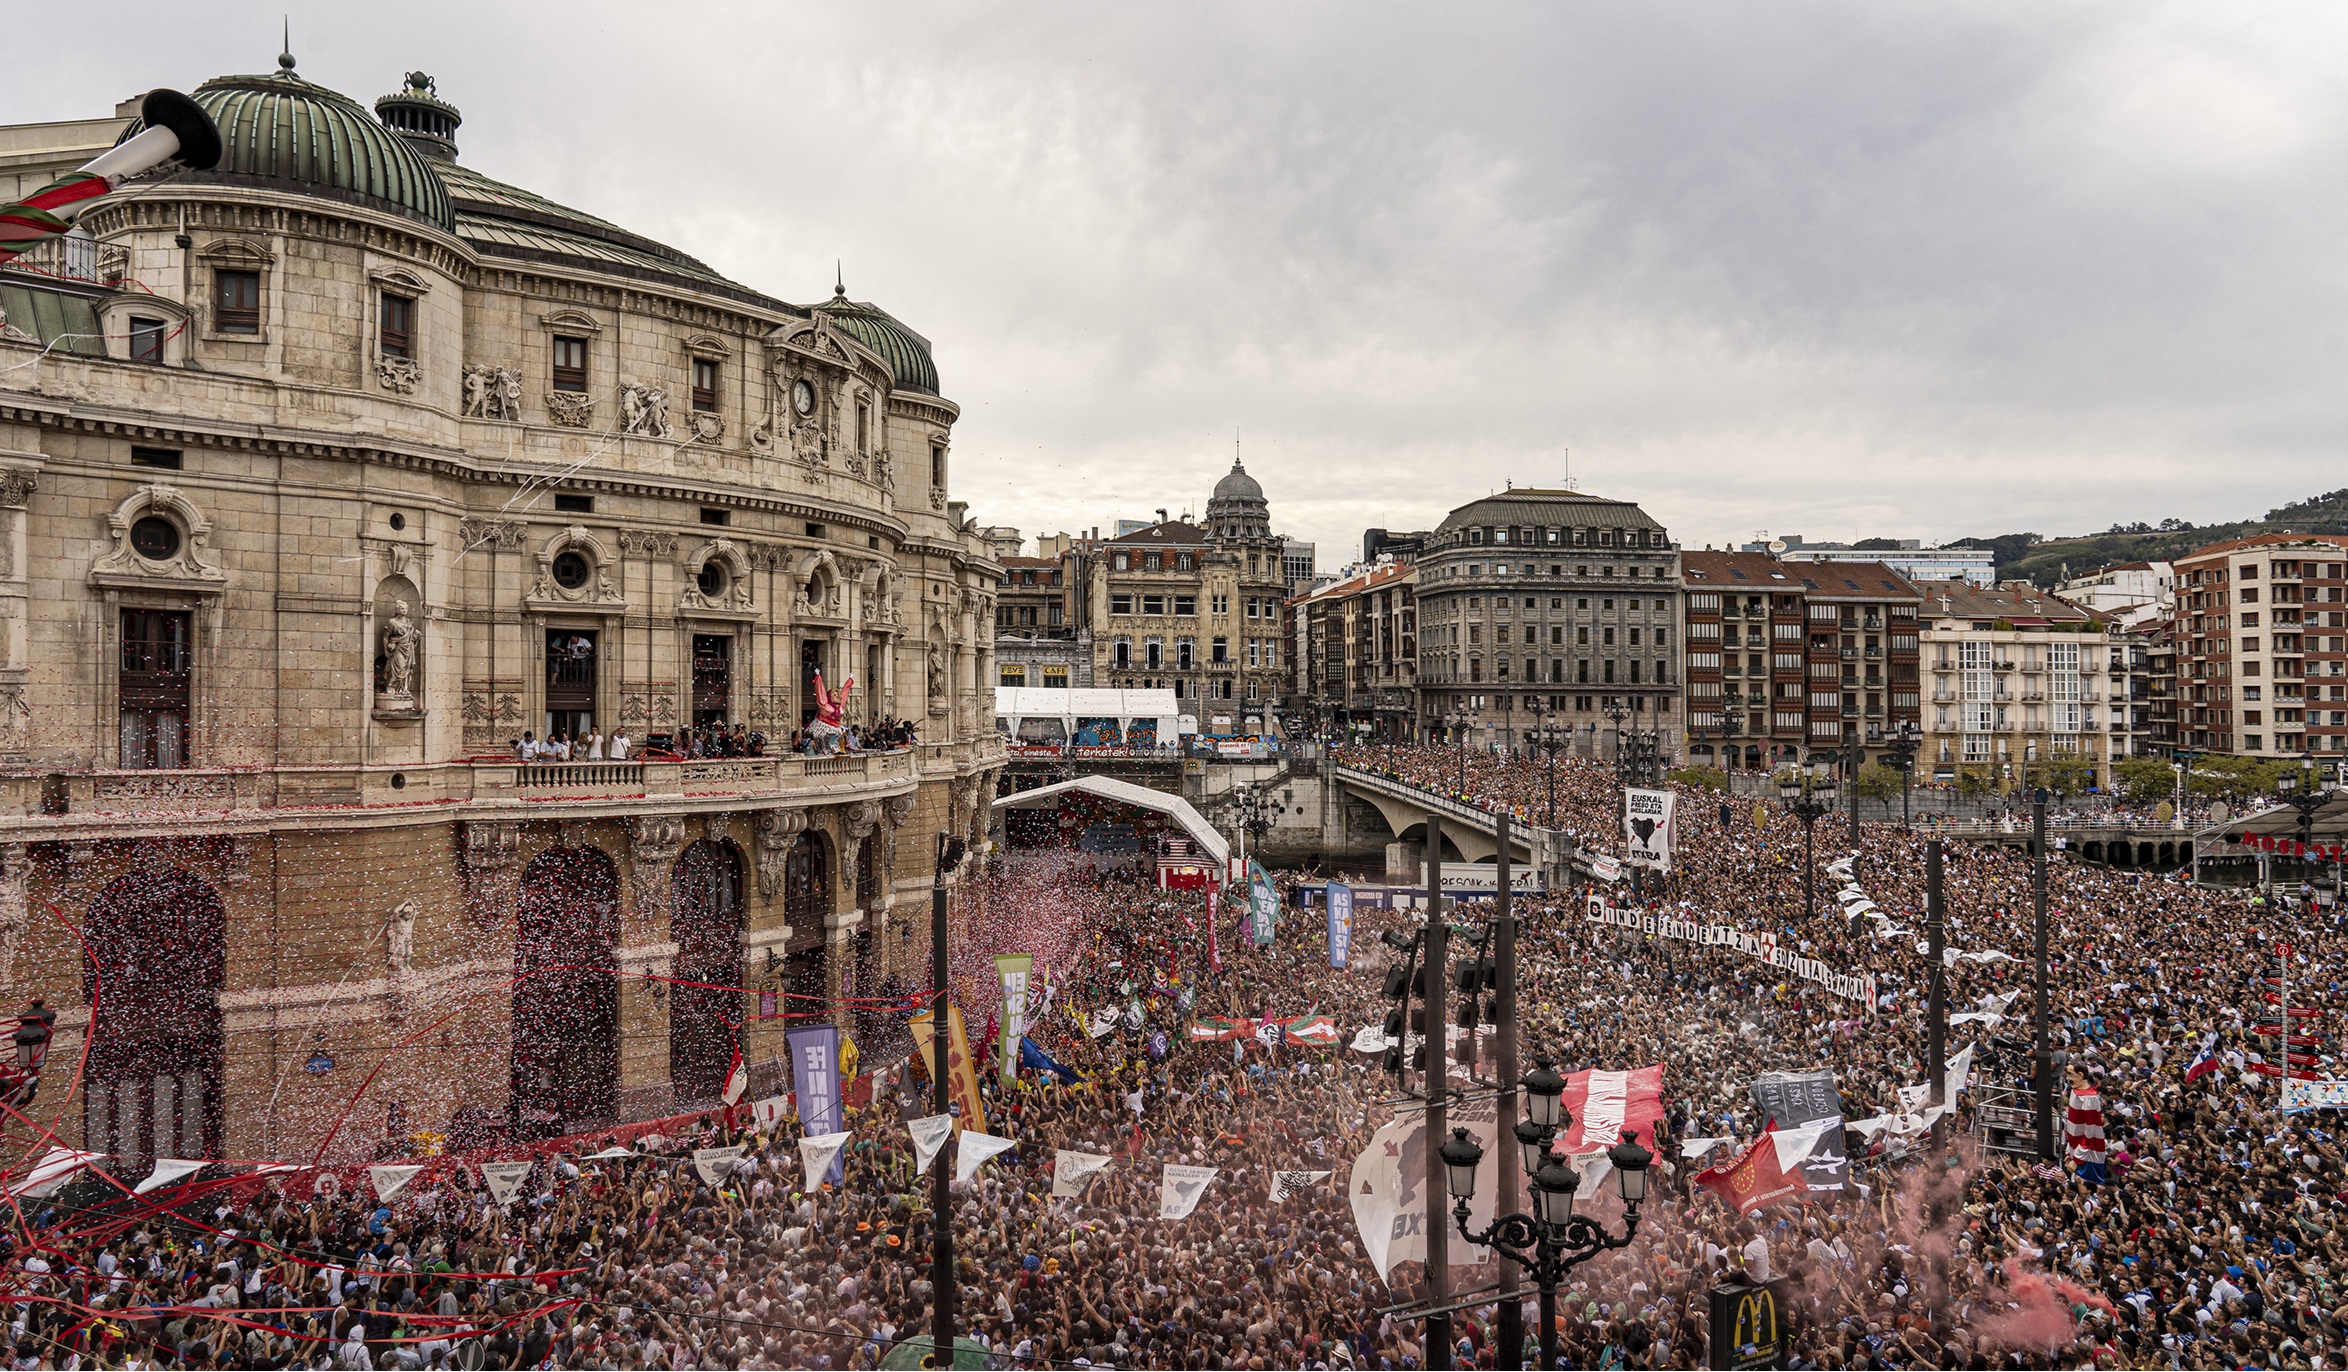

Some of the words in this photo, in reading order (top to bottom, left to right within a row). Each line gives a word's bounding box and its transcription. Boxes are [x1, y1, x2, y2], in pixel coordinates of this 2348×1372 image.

[1631, 794, 1663, 804] EUSKAL
[1333, 892, 1348, 906] AS
[1608, 906, 1759, 954] INDEPENDENTZIA
